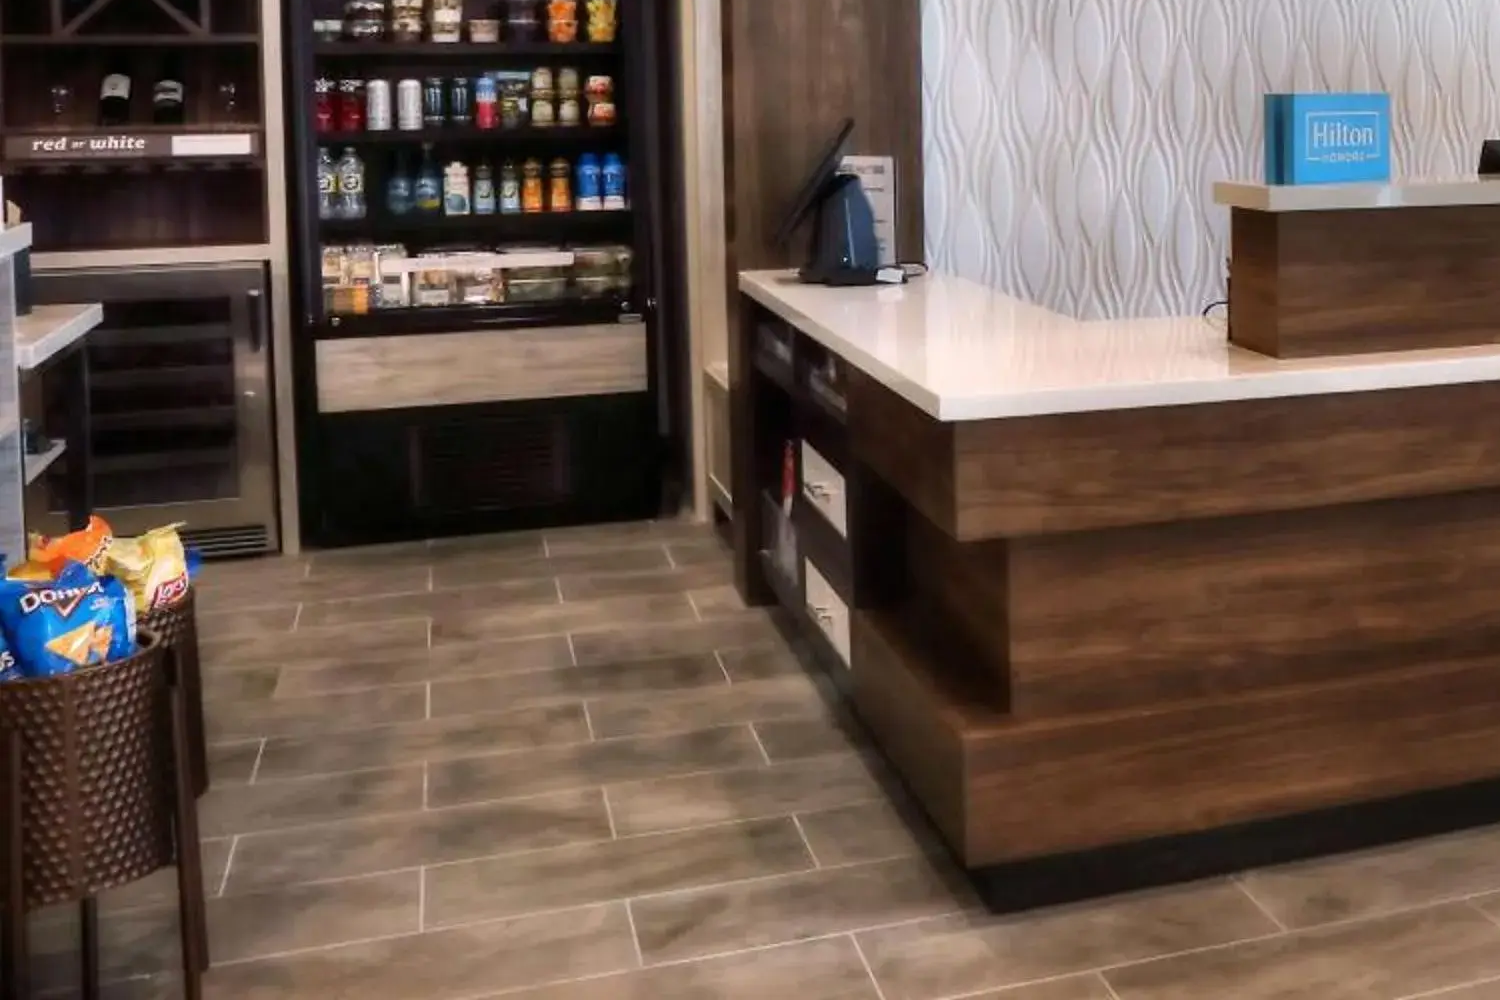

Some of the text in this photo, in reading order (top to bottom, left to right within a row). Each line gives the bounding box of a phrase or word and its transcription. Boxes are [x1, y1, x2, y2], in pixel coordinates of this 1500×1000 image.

[32, 136, 67, 151] red
[89, 135, 146, 150] white
[1312, 121, 1374, 149] Hilton
